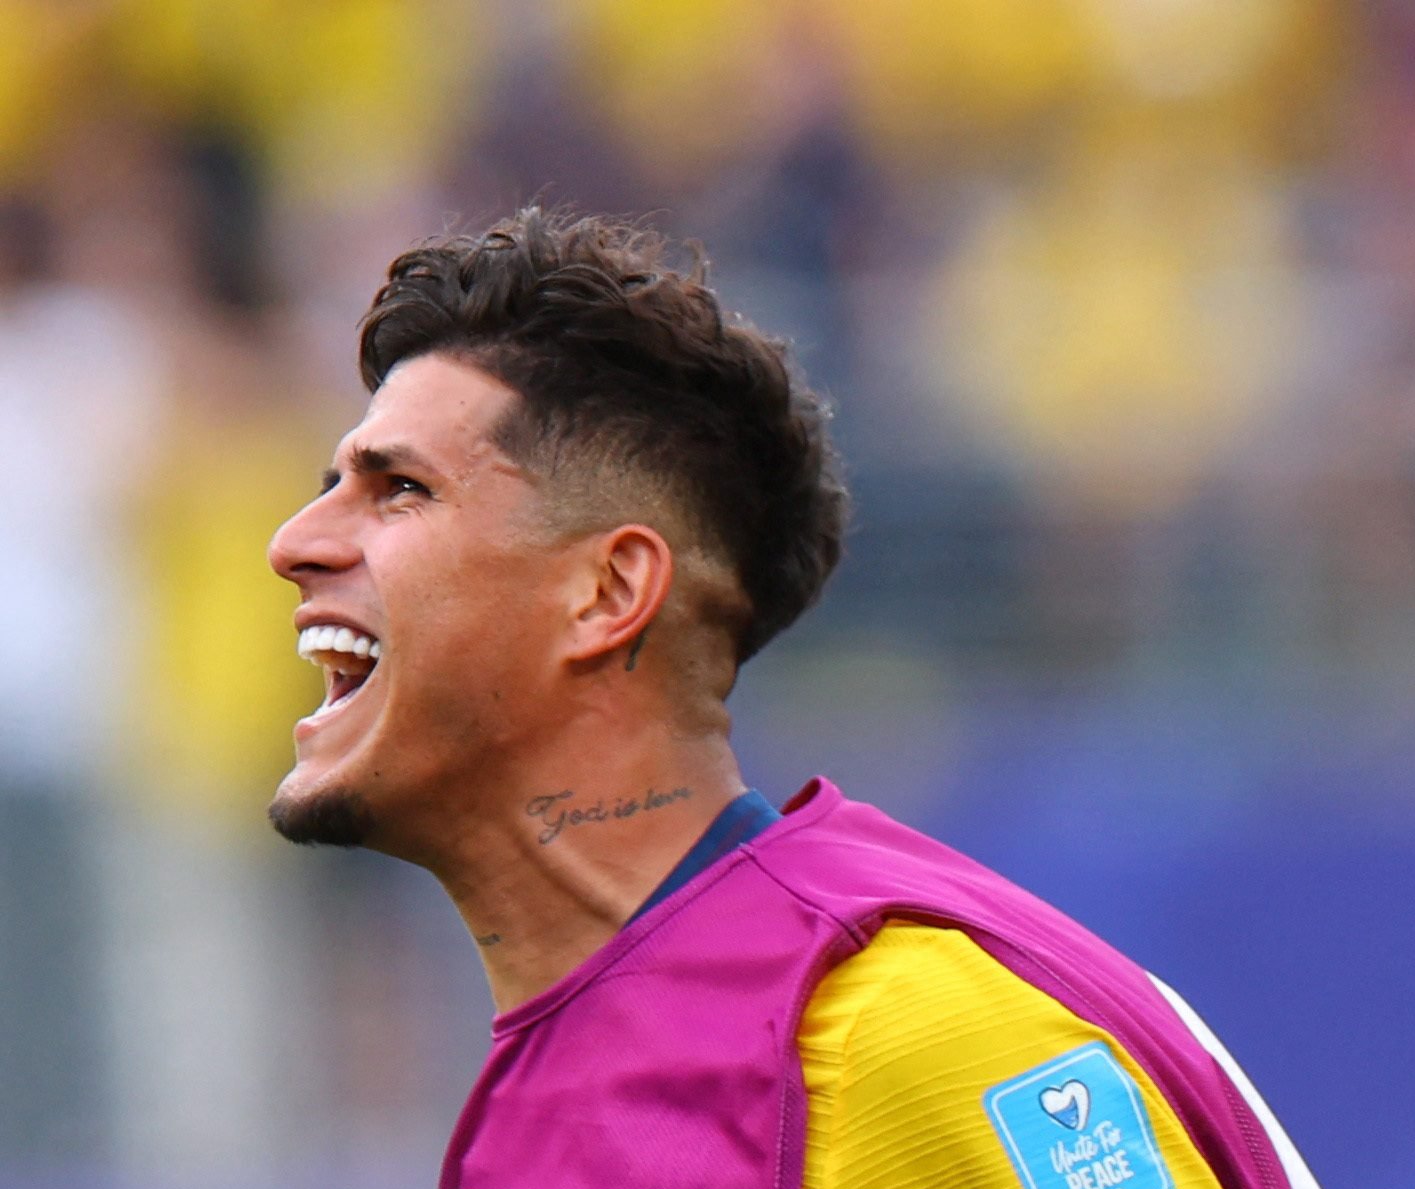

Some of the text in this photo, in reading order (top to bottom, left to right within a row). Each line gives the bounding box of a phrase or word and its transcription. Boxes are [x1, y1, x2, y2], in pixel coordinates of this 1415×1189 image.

[526, 789, 608, 845] God
[614, 798, 642, 819] is
[1051, 1134, 1098, 1174] Unite
